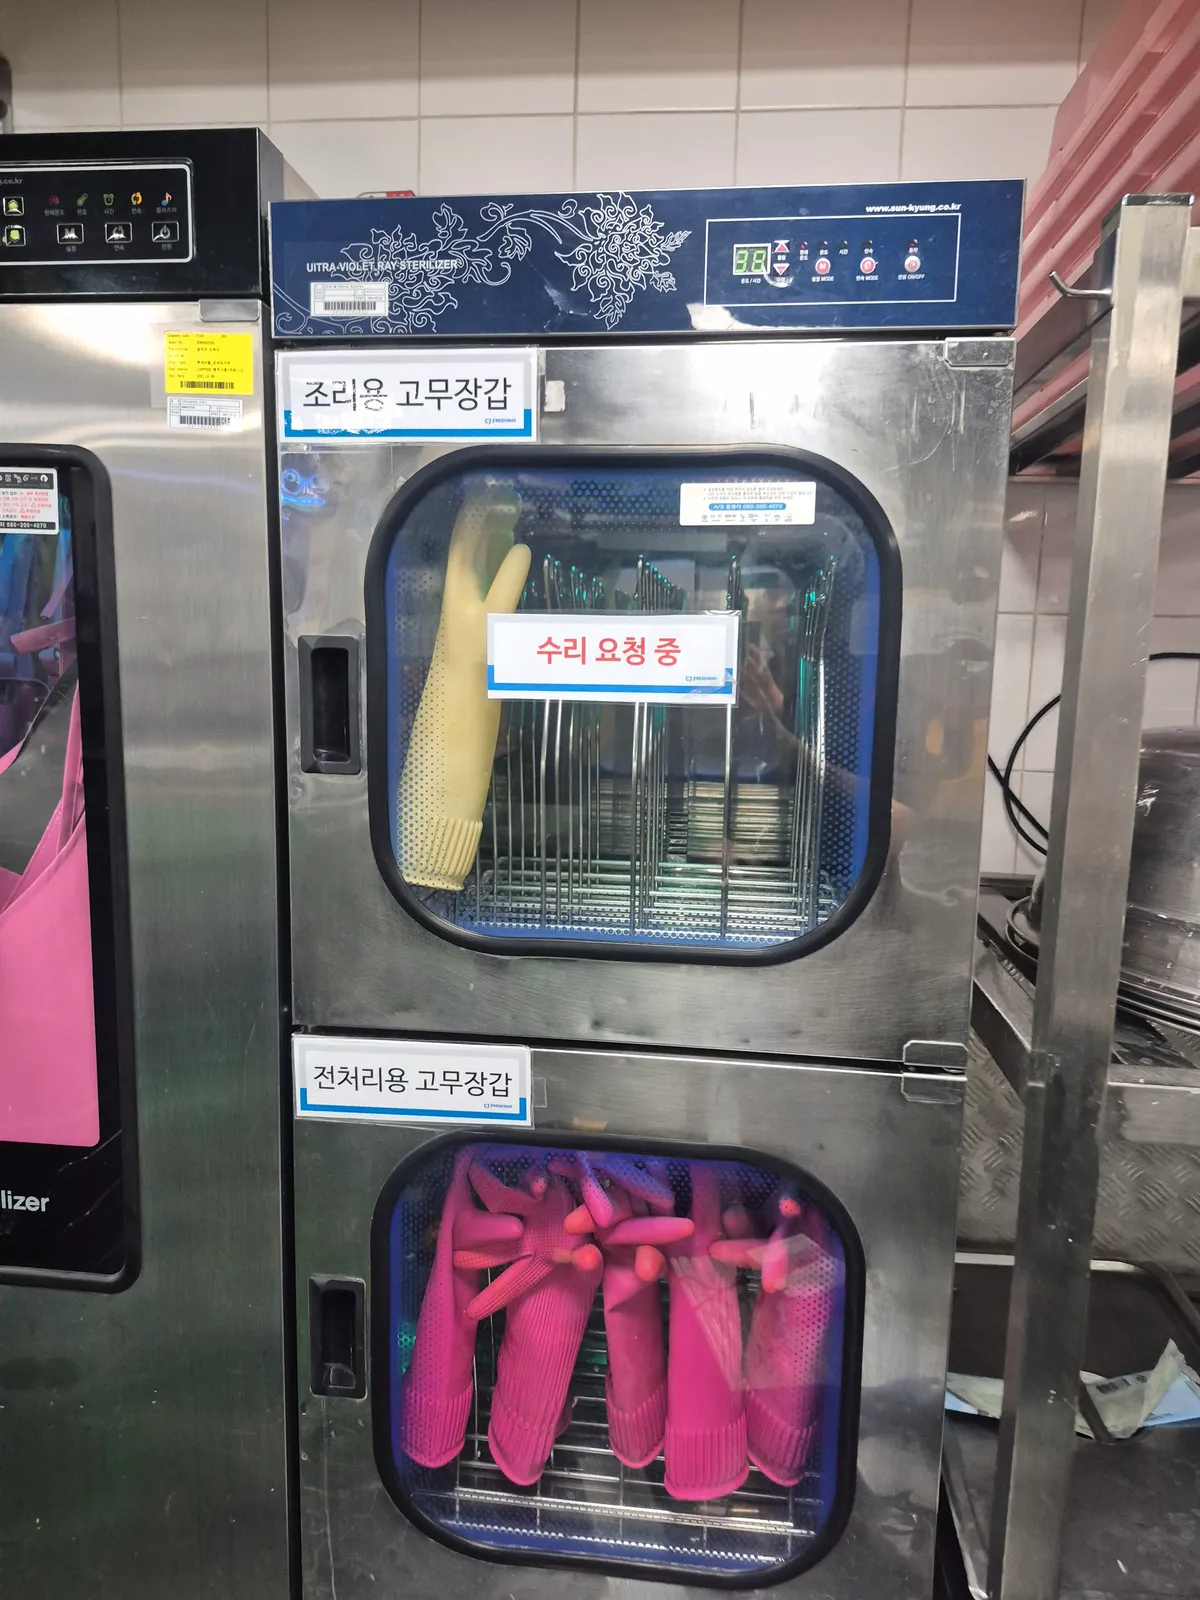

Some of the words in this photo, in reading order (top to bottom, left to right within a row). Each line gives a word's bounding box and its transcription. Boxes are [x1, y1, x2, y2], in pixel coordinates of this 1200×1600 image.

[865, 203, 962, 213] www.sun-kyung.co.kr
[377, 261, 397, 272] RAY
[399, 259, 459, 271] STERILIZER
[302, 377, 389, 412] 조리용
[395, 376, 513, 412] 고무장갑
[536, 636, 587, 665] 수리
[595, 636, 646, 666] 요청
[653, 637, 682, 667] 중
[313, 1065, 409, 1094] 전처리용
[415, 1070, 513, 1098] 고무장갑
